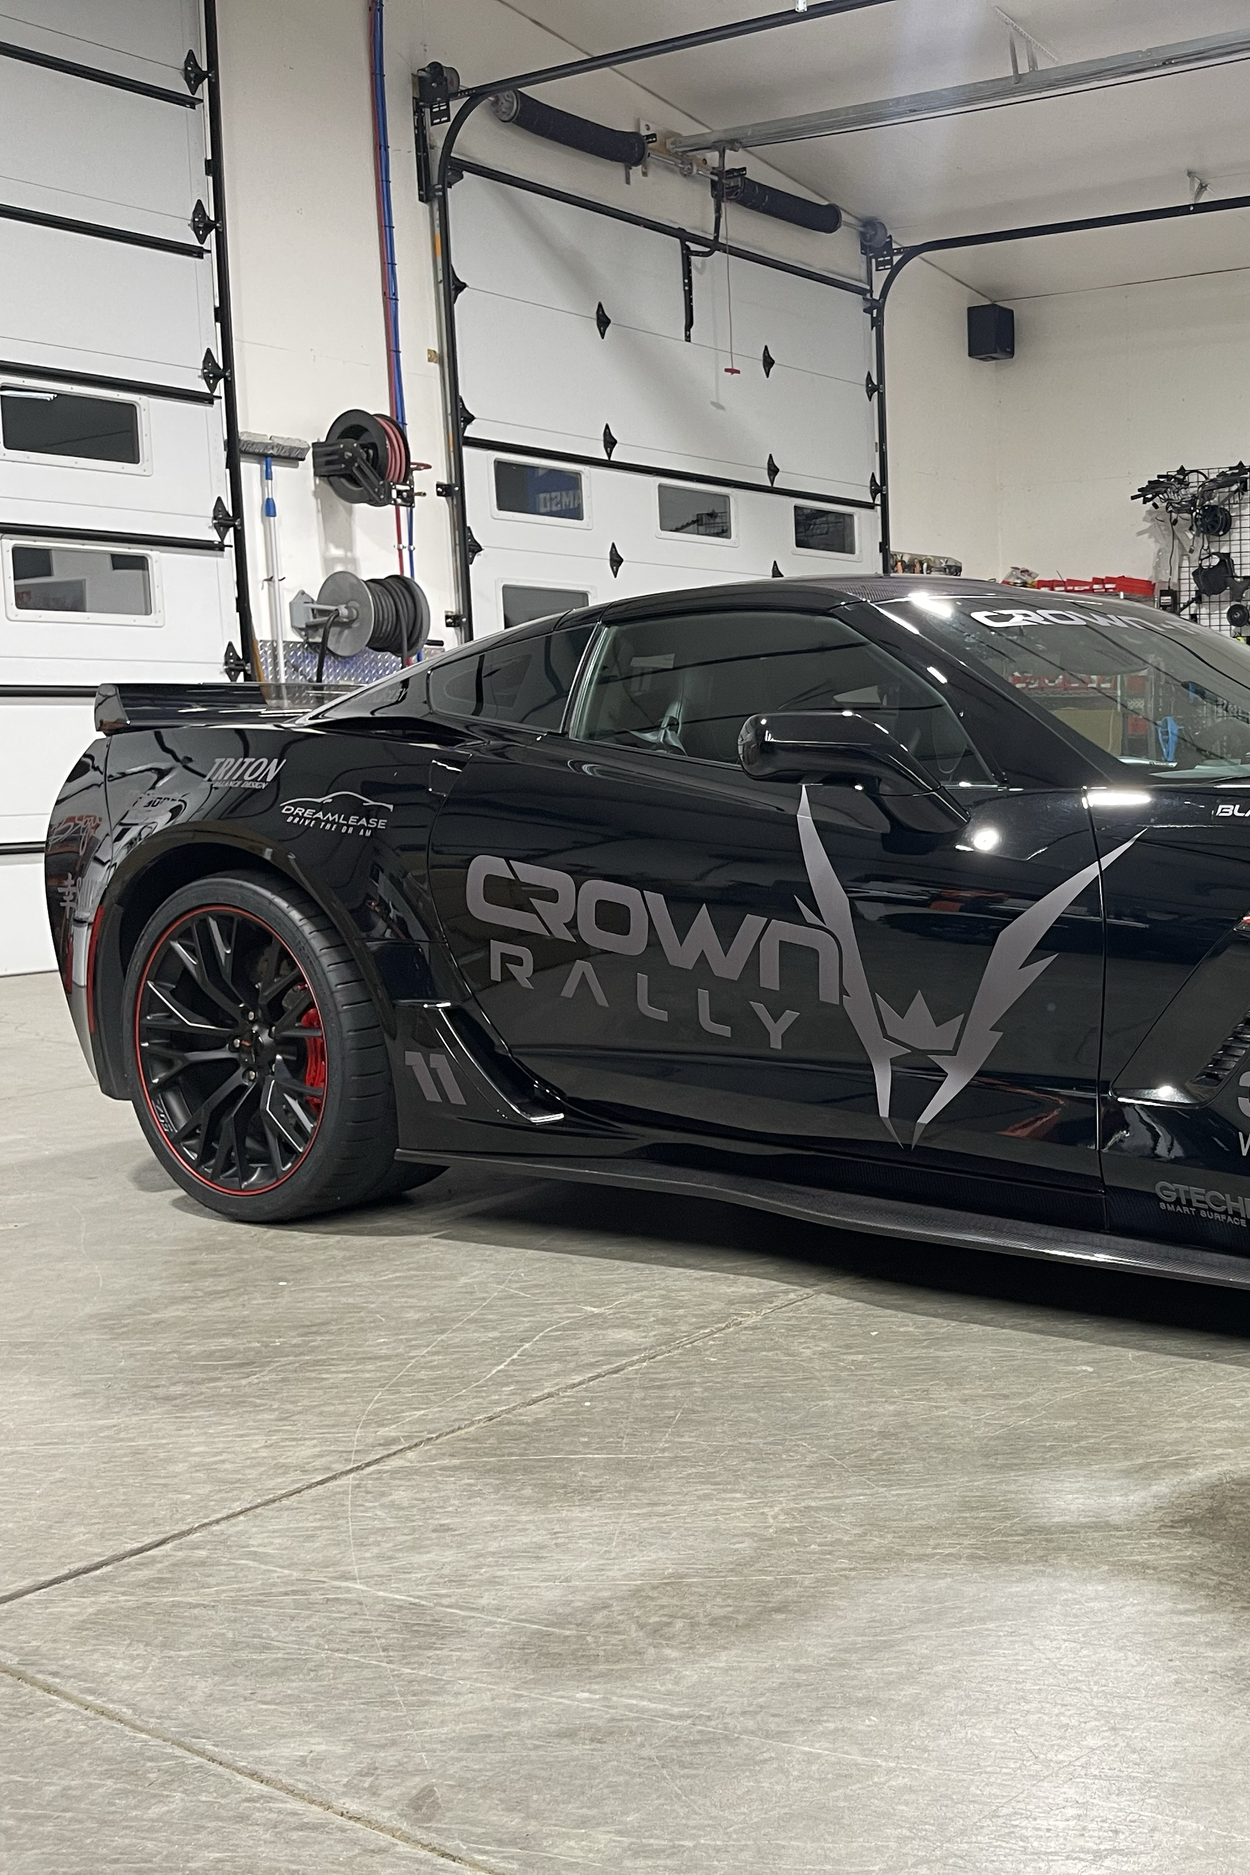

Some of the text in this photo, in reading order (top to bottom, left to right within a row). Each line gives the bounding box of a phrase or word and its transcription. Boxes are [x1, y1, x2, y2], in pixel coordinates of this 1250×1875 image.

[203, 757, 287, 782] TRITON
[281, 805, 388, 829] DREAMLEASE
[286, 816, 316, 827] DRIVE
[319, 821, 338, 831] THE
[466, 854, 840, 1005] CROWN
[490, 938, 800, 1050] RALLY
[405, 1050, 467, 1106] 11
[1159, 1202, 1196, 1216] SMART
[1200, 1210, 1247, 1228] SURFACE
